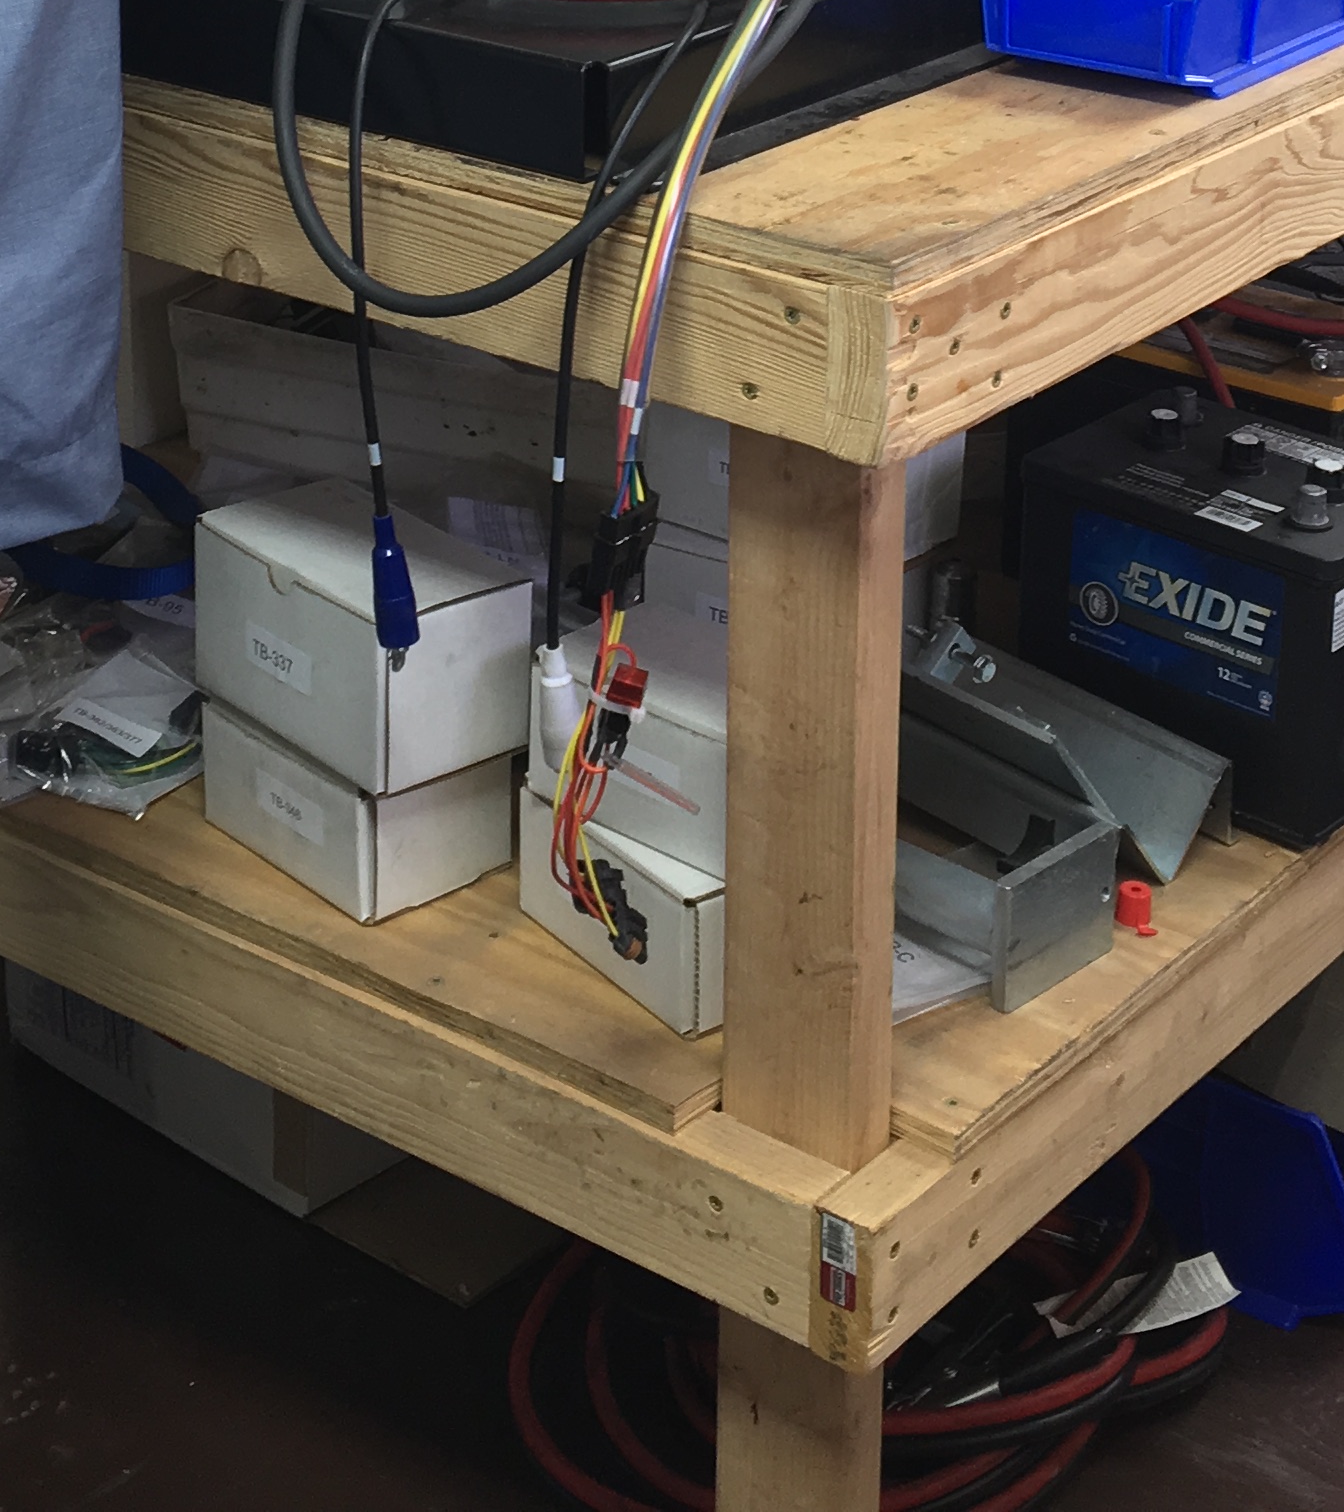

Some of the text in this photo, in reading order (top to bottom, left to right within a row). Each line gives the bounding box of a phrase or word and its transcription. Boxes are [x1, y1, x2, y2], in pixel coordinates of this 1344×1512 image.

[1119, 561, 1273, 647] EXIDE
[252, 638, 295, 675] TB-337
[1183, 630, 1263, 666] COMMERCIAL SERIES
[1217, 666, 1232, 682] 12
